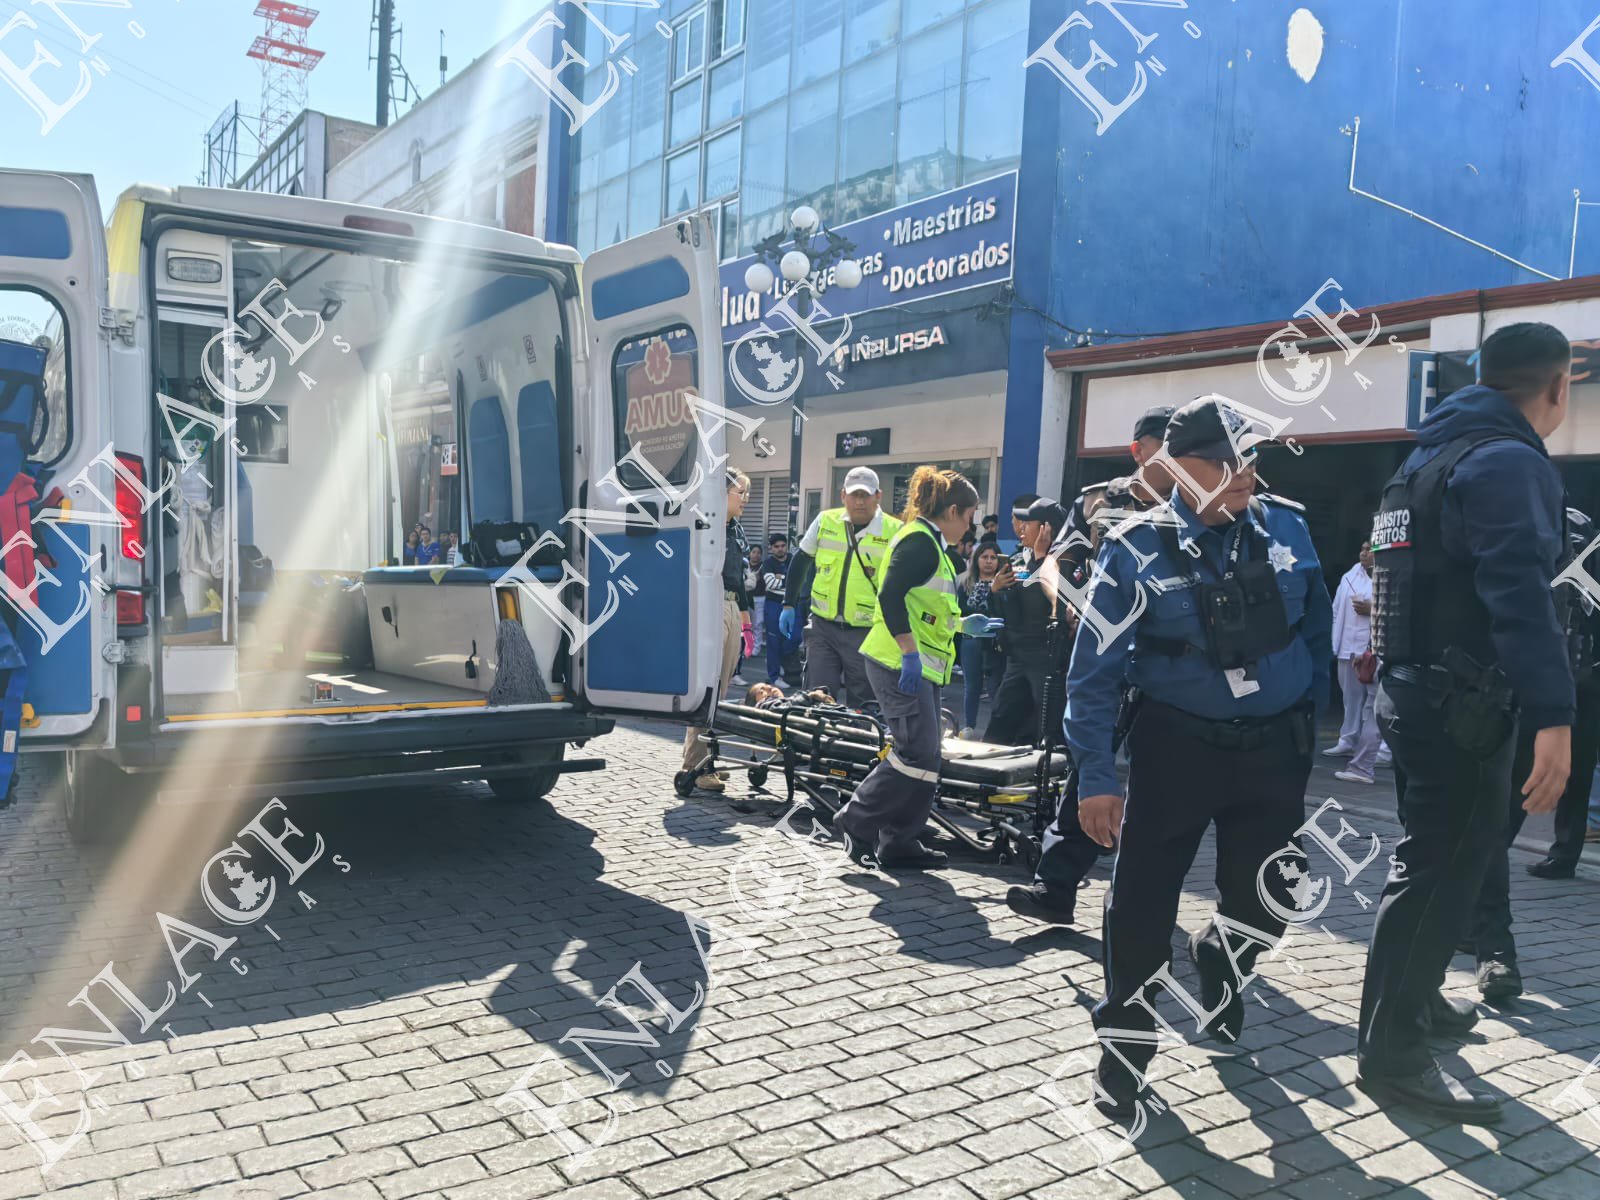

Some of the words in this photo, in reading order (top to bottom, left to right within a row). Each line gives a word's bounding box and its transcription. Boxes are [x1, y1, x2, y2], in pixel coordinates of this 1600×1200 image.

[892, 195, 998, 247] Maestrías
[889, 239, 1010, 293] Doctorados
[851, 325, 945, 363] INBURSA
[1371, 525, 1408, 545] PERITOS
